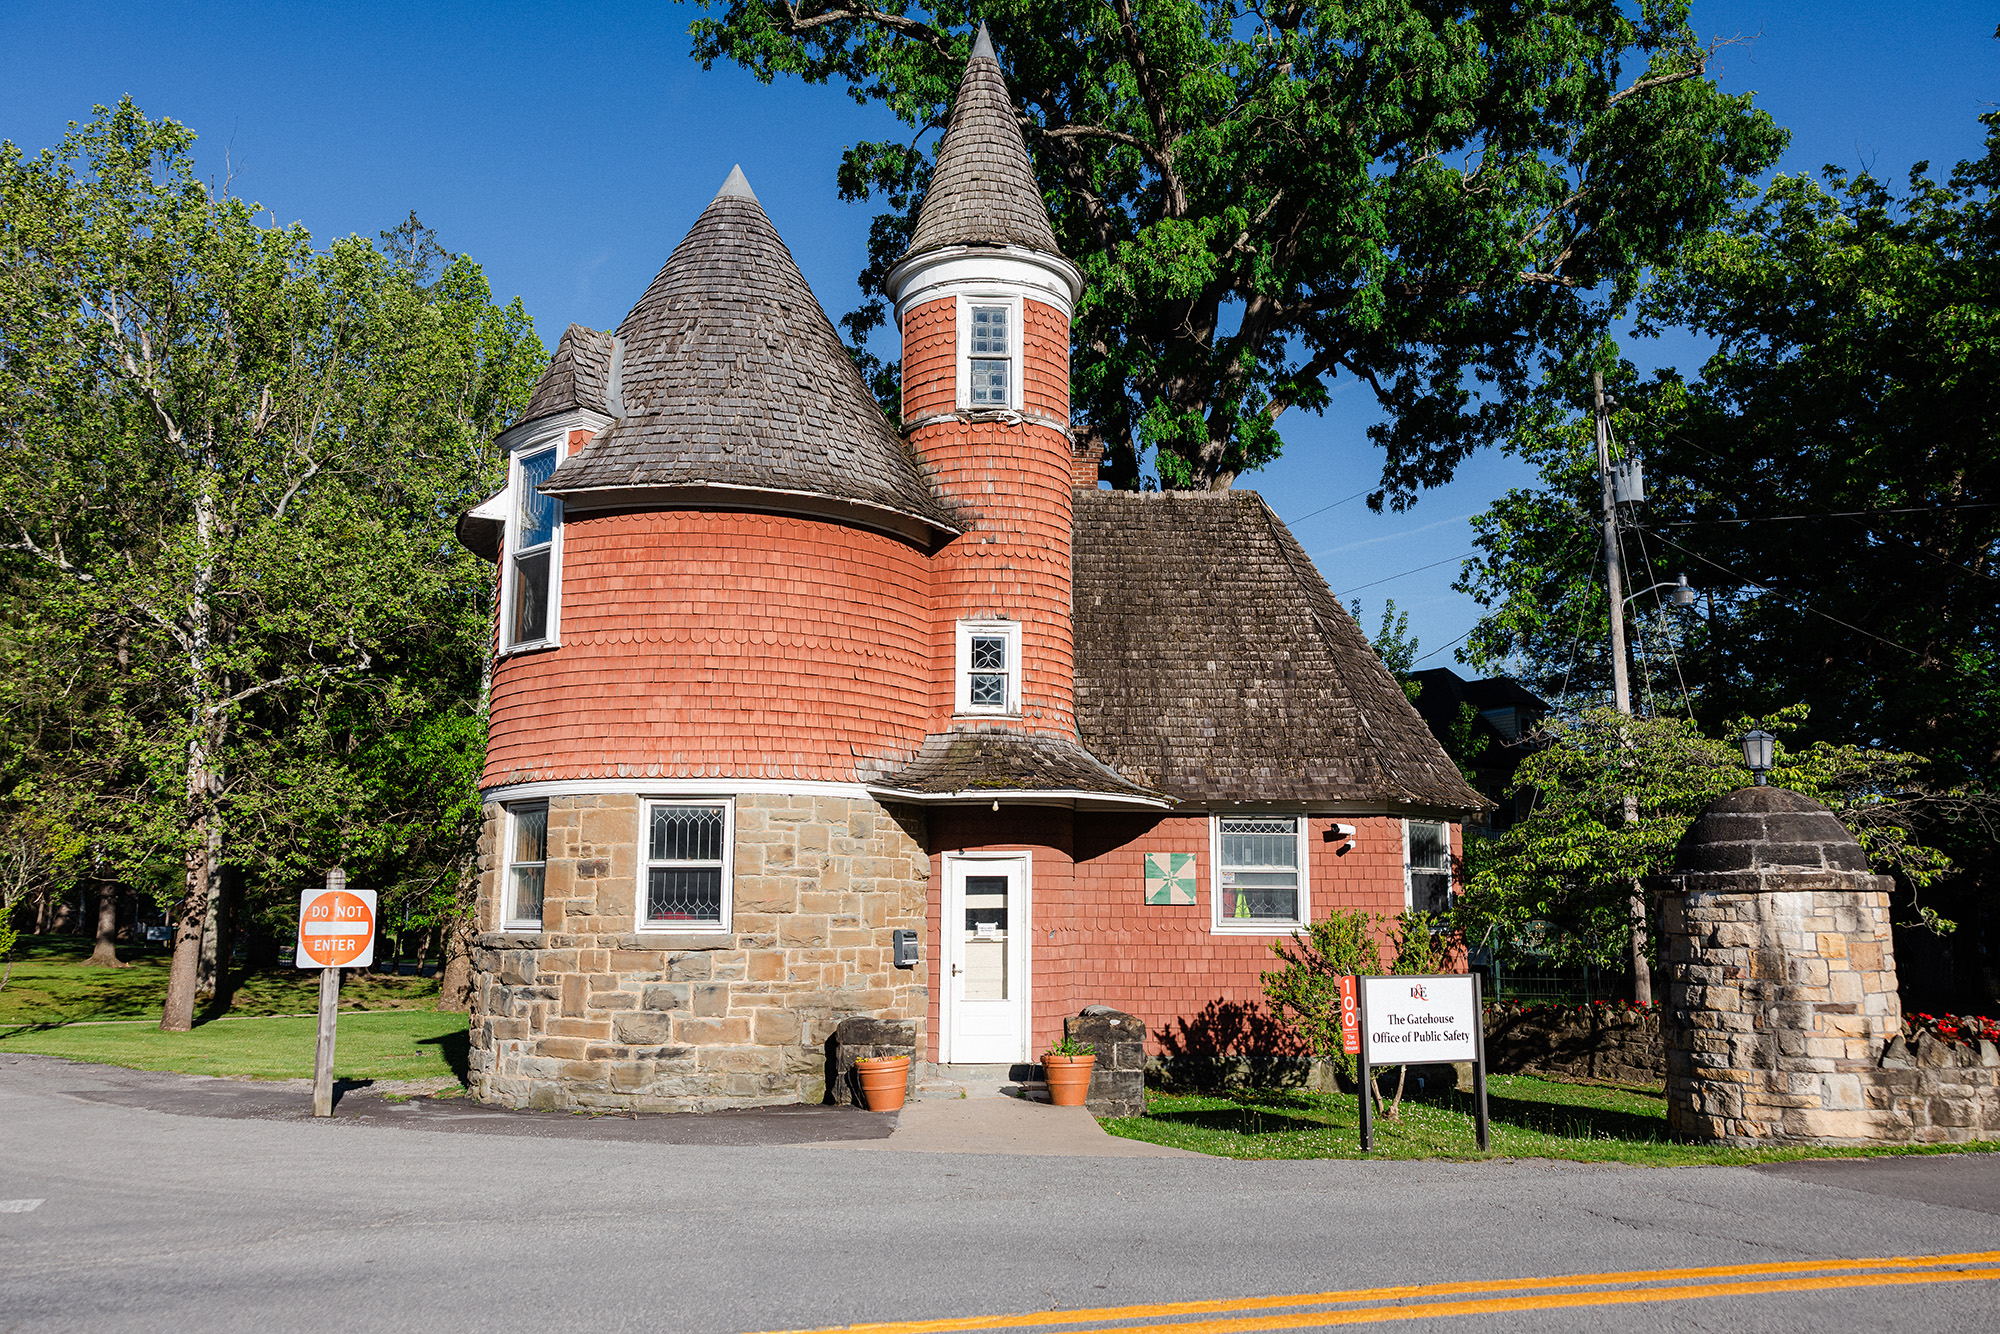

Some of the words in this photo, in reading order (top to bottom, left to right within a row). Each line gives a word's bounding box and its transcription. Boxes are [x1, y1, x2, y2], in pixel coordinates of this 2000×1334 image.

[312, 905, 329, 918] DO
[336, 905, 364, 918] NOT
[314, 939, 356, 951] ENTER
[1344, 978, 1355, 1027] 100
[1387, 1013, 1406, 1025] The
[1406, 1013, 1455, 1025] Gatehouse
[1372, 1031, 1401, 1043] Office
[1401, 1030, 1412, 1042] of
[1413, 1030, 1442, 1042] Public
[1443, 1029, 1470, 1043] Safety
